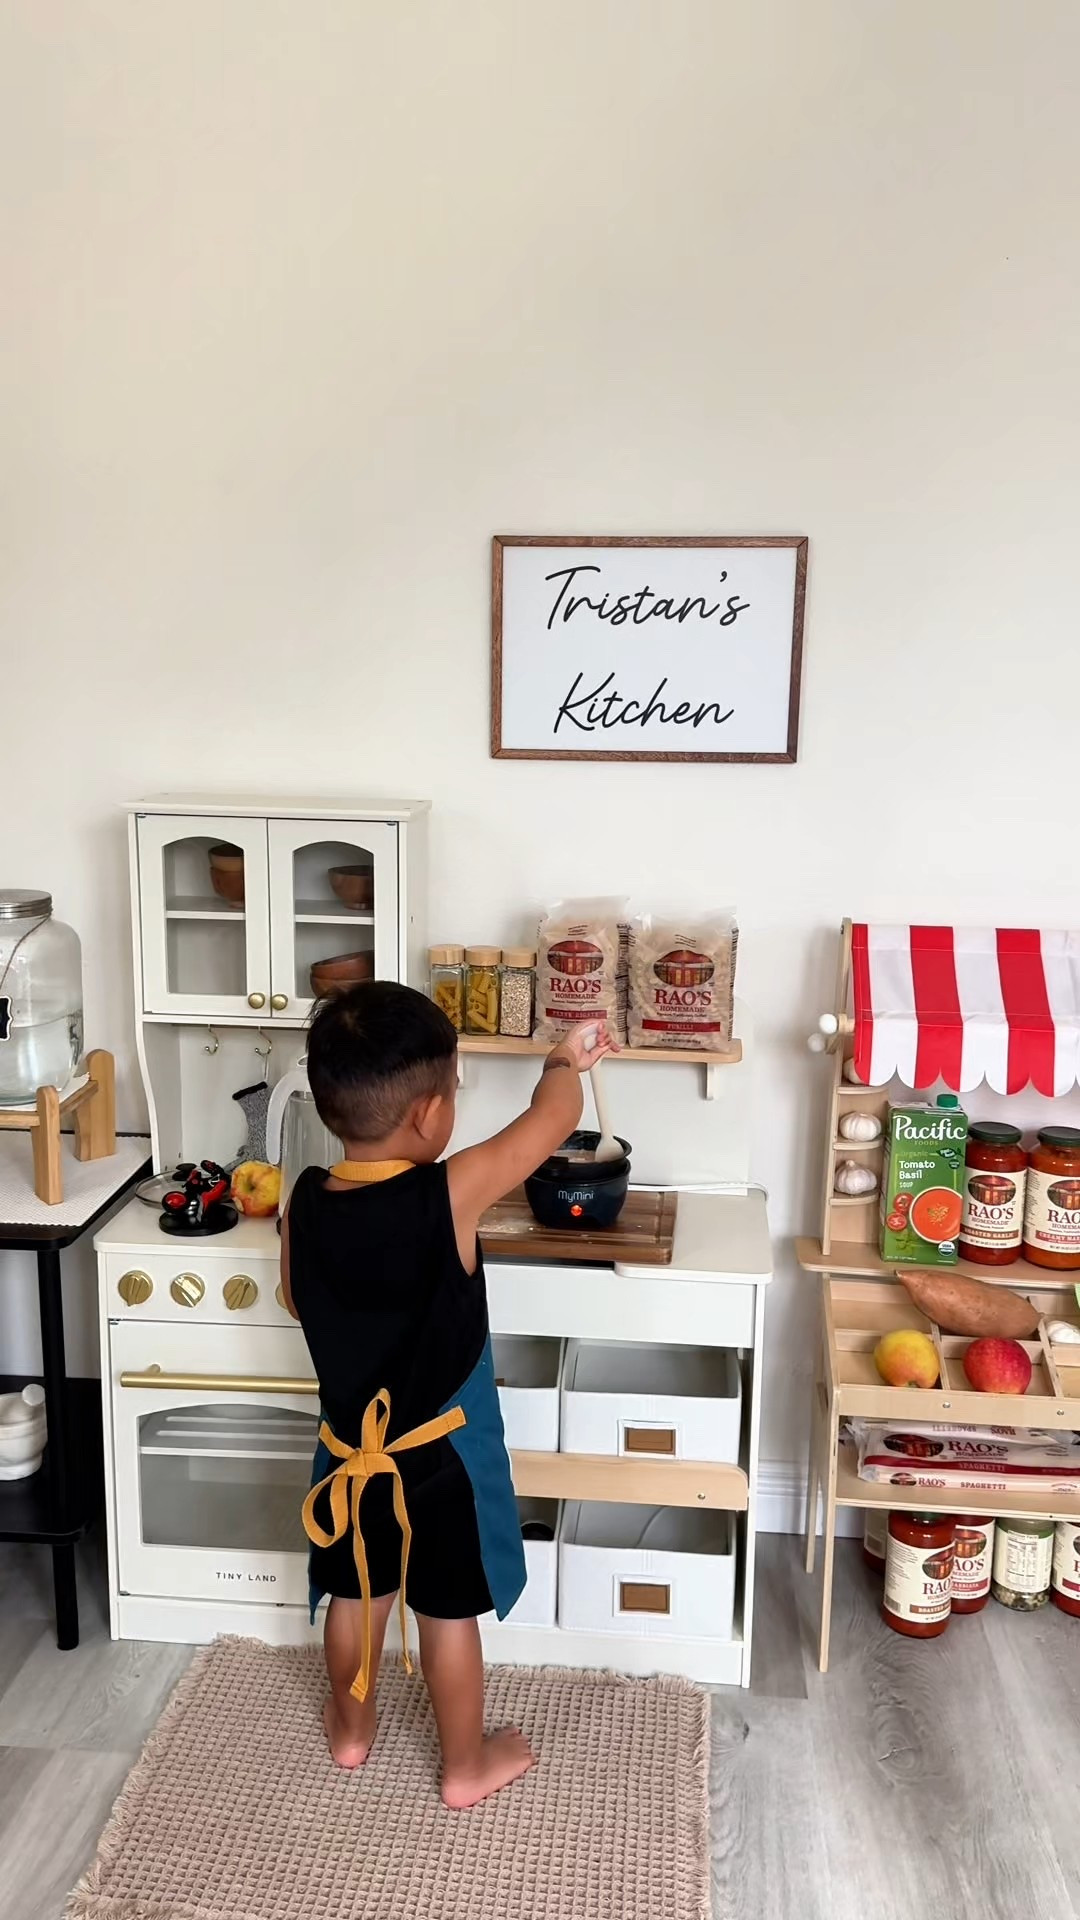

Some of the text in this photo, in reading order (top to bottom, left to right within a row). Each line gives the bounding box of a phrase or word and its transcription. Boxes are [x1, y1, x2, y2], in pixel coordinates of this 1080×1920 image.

[545, 565, 751, 630] Tristan's
[553, 672, 735, 733] Kitchen
[549, 977, 602, 993] RAO'S
[653, 988, 712, 1006] RAO'S
[660, 1005, 705, 1013] HOMEMADE
[893, 1115, 967, 1140] Pacific
[899, 1160, 936, 1169] Tomato
[899, 1169, 923, 1179] Basil
[558, 1190, 594, 1202] MyMini
[968, 1202, 1014, 1220] RAO'S
[1047, 1208, 1080, 1225] RAO
[971, 1216, 1010, 1226] HOMEMADE
[948, 1440, 1009, 1453] RAO'S
[958, 1462, 1006, 1472] SPAGHETTI
[918, 1477, 1007, 1490] RAO'S SPAGHETTI
[954, 1558, 985, 1571] AO'S
[216, 1572, 277, 1582] TINY LAND
[922, 1577, 951, 1595] RAO
